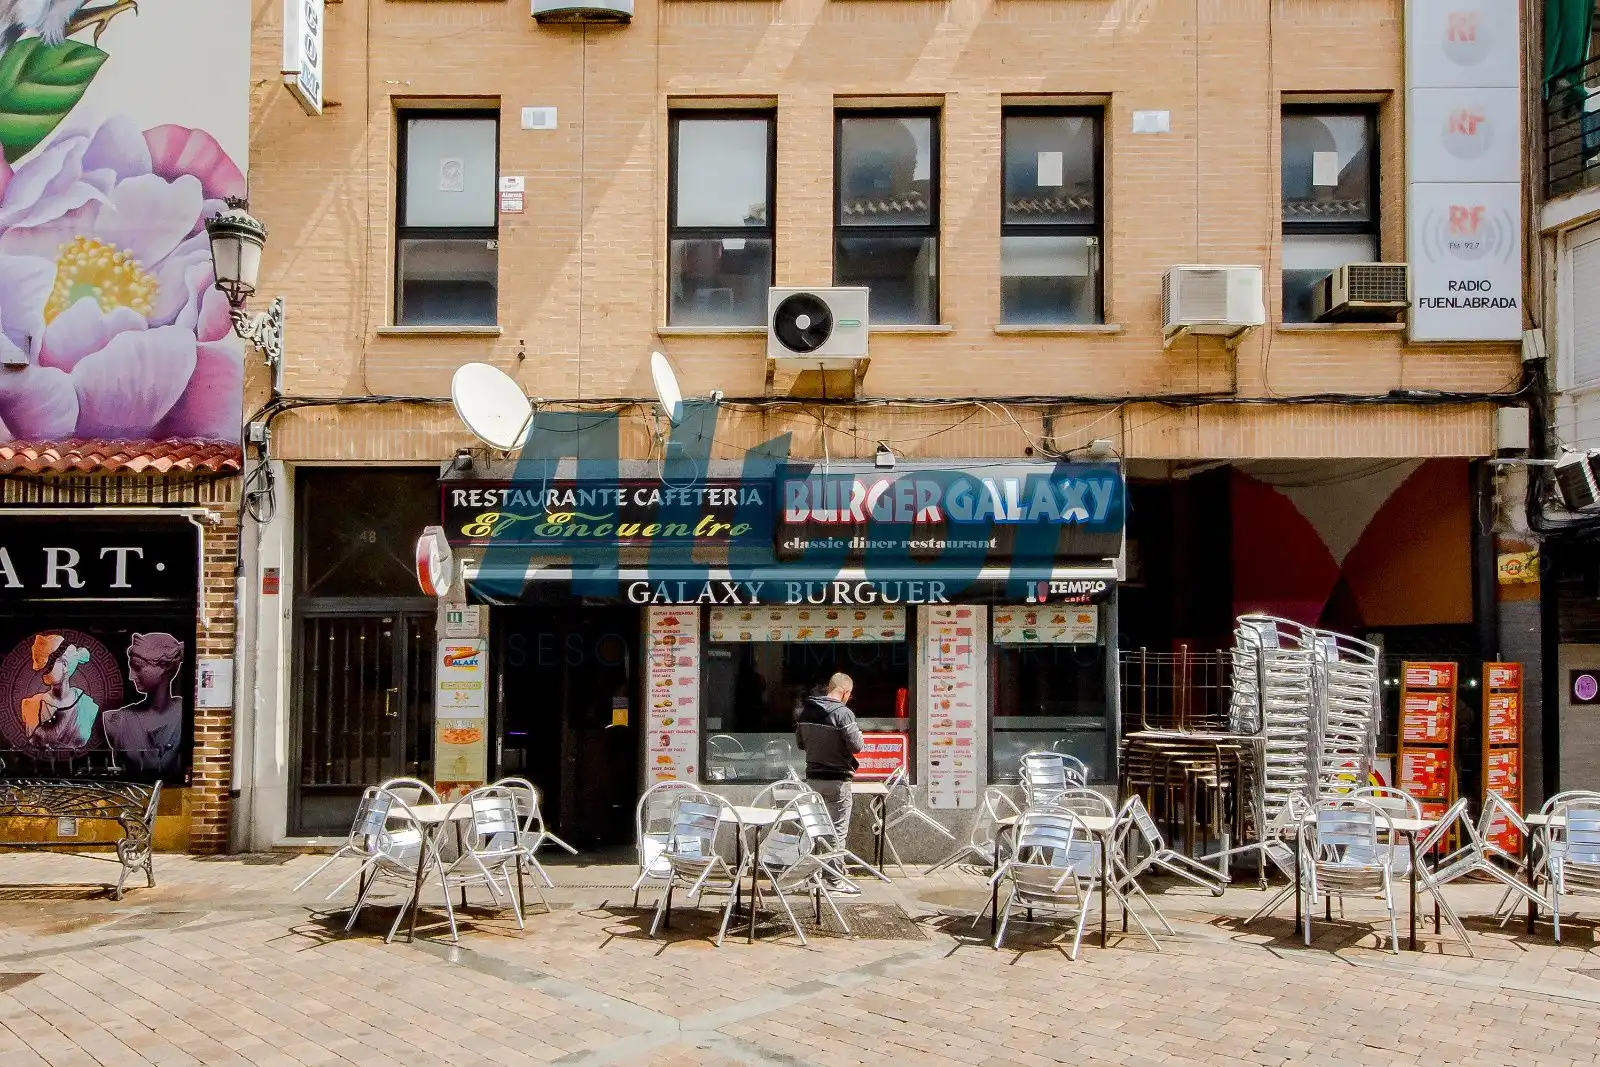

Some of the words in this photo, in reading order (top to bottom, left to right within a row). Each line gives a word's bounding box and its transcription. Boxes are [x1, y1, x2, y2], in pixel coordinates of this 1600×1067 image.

[1449, 205, 1486, 234] RF
[1464, 242, 1480, 250] 92.7
[1448, 280, 1492, 292] RADIO
[1419, 297, 1518, 309] FUENLABRADA
[452, 488, 627, 508] RESTAURANTE
[634, 488, 764, 508] CAFETERIA
[784, 477, 943, 524] BURGER
[944, 476, 1117, 524] GALAXY
[461, 511, 542, 538] El
[535, 511, 753, 538] Encuentro
[784, 536, 844, 550] classic
[848, 536, 897, 550] diner
[901, 536, 999, 550] restaurant
[628, 580, 765, 605] GALAXY
[785, 580, 950, 605] BURGUER
[1049, 580, 1106, 594] TEMPLO
